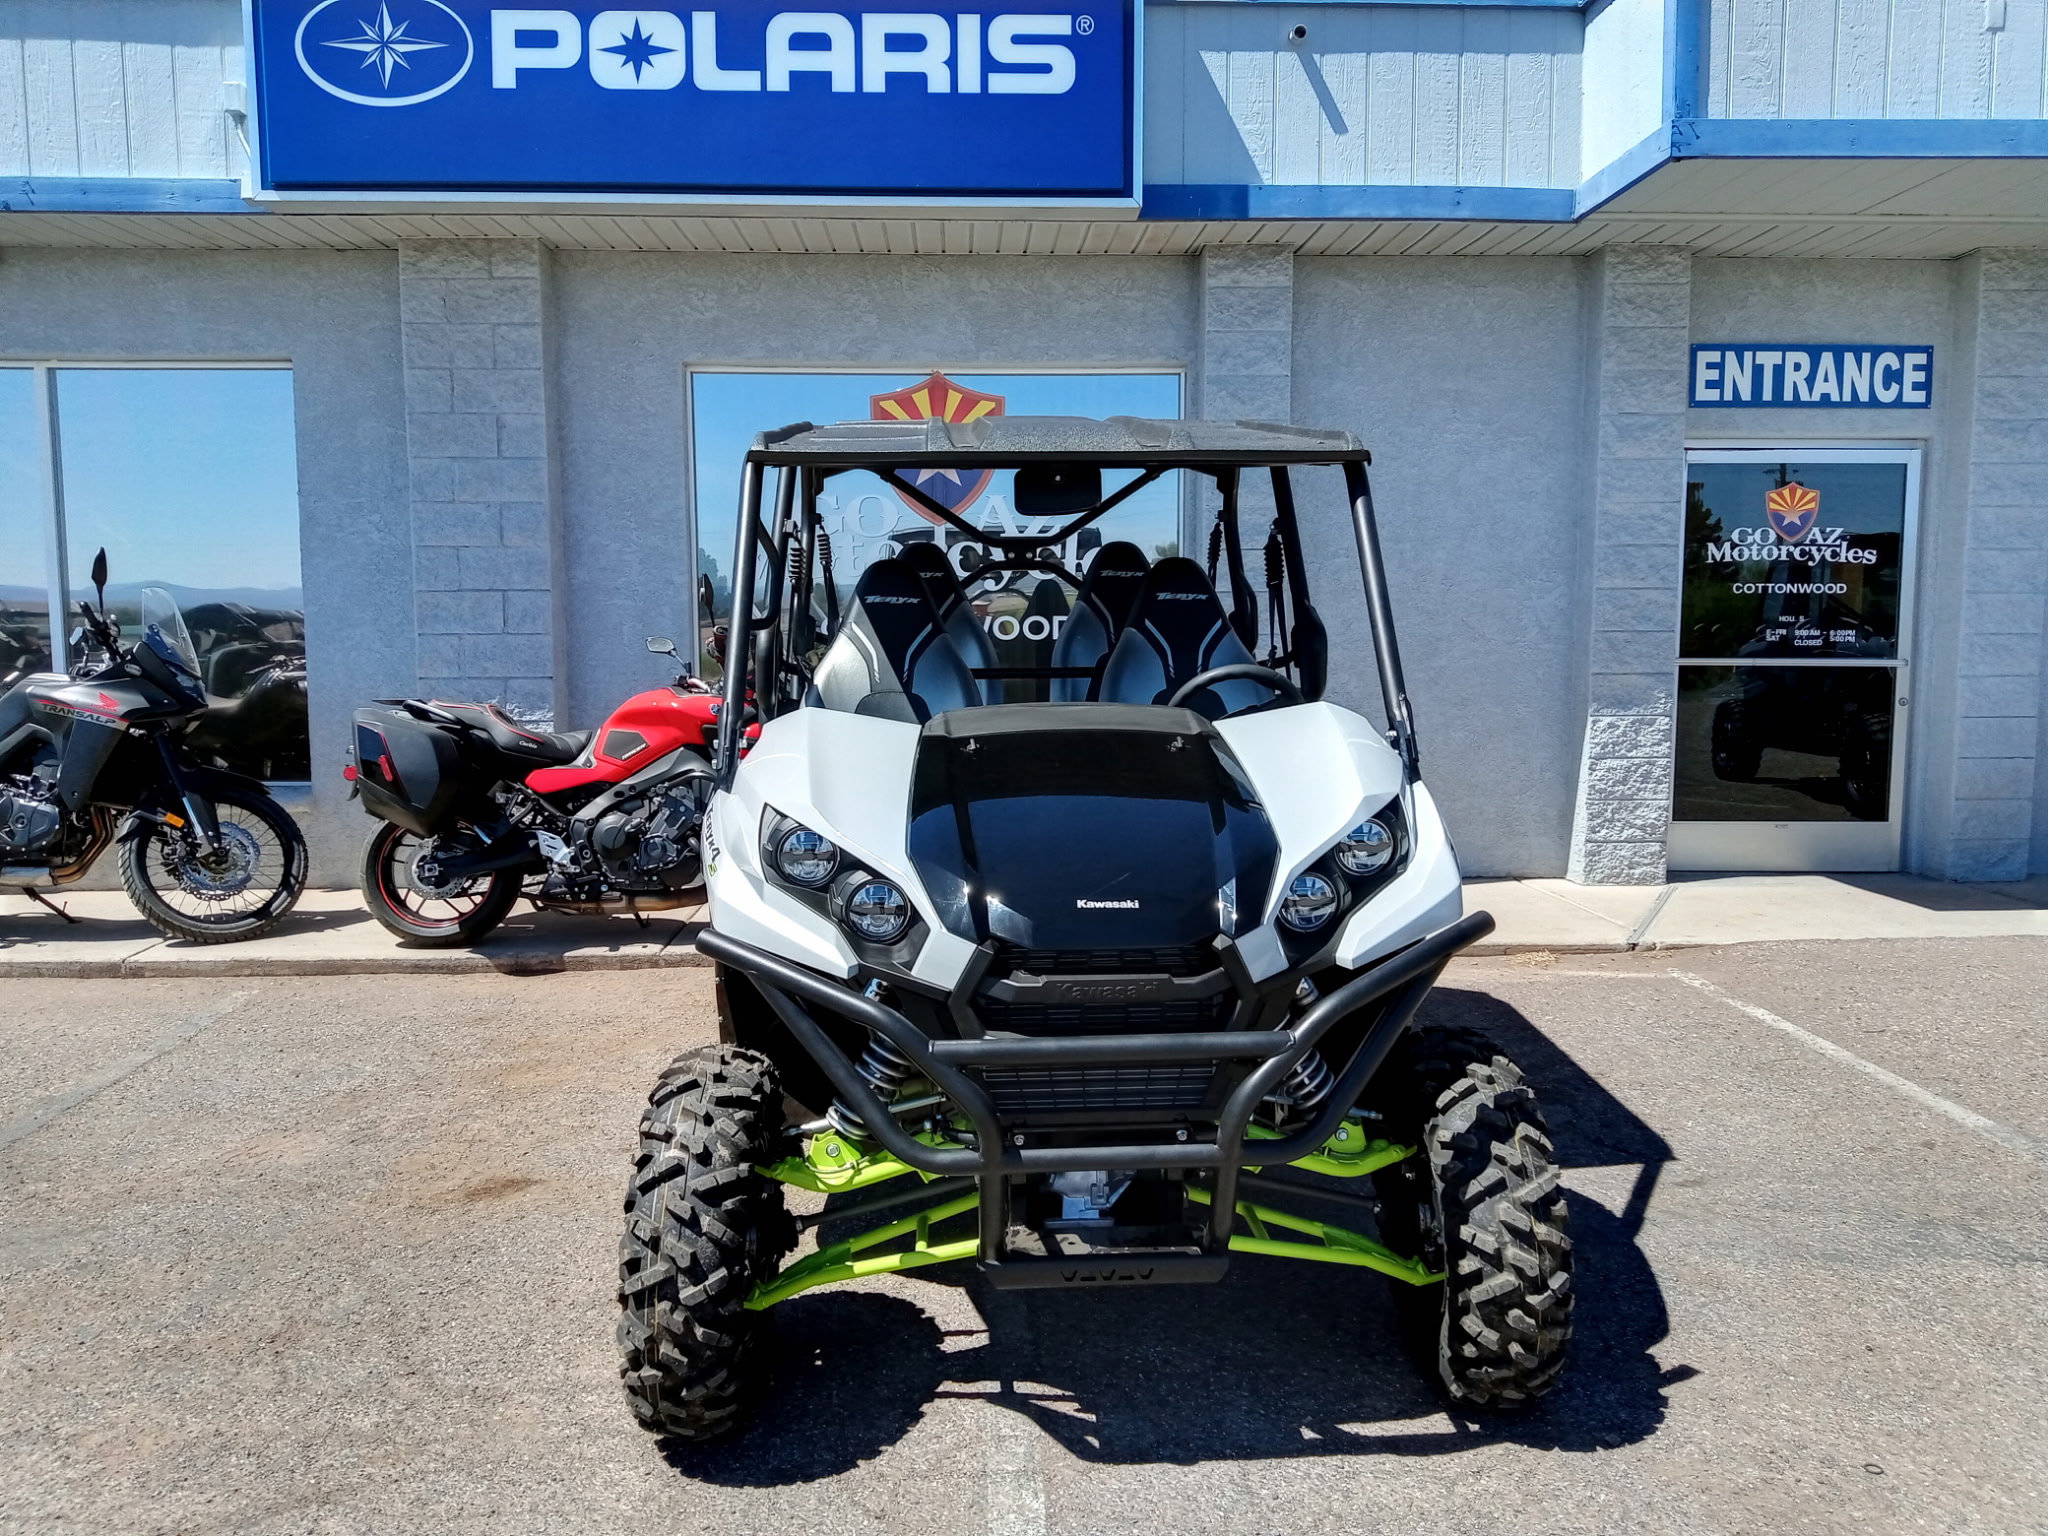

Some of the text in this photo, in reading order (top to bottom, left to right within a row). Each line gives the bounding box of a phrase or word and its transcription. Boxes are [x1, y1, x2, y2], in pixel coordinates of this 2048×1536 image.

[491, 9, 1077, 95] POLARIS
[1695, 350, 1928, 404] ENTRANCE
[1730, 527, 1845, 545] GO AZ
[1705, 541, 1878, 567] Motorcycles
[1732, 583, 1848, 594] COTTONWOOD
[42, 703, 117, 725] TRANSALP
[1076, 899, 1140, 909] Kawasaki
[1056, 980, 1160, 1000] Kawasaki
